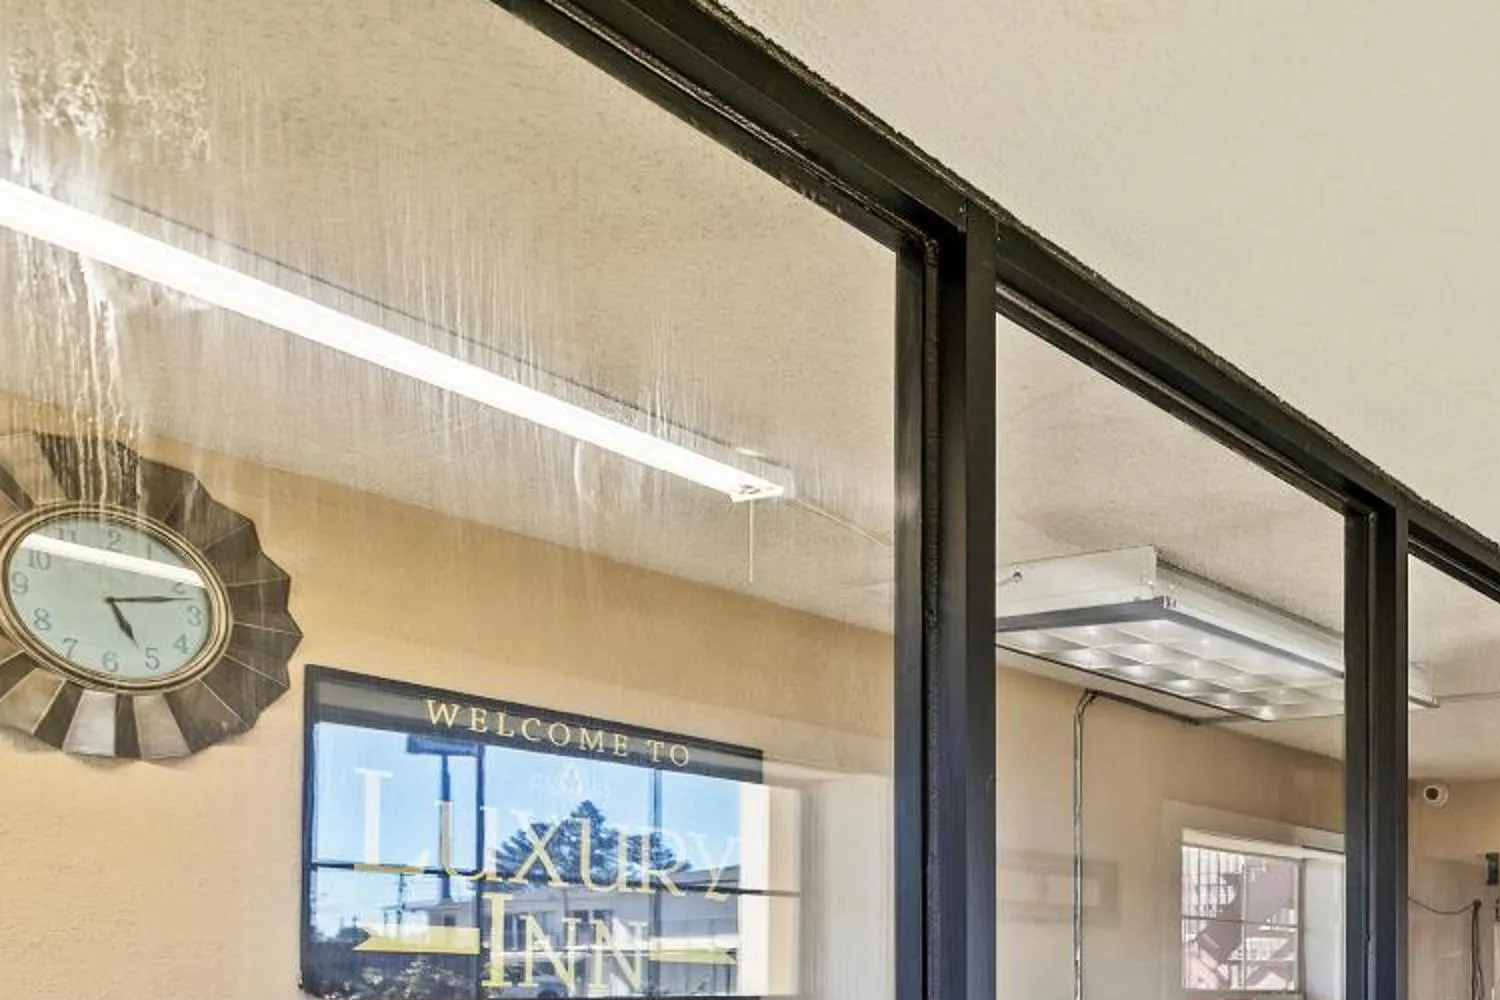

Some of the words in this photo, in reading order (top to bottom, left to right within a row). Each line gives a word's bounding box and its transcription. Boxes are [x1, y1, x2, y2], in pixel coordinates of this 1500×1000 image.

[28, 550, 50, 571] 10
[11, 572, 28, 595] 9
[33, 607, 51, 630] 8
[187, 605, 202, 627] 3
[63, 637, 80, 658] 7
[173, 632, 188, 654] 4
[103, 652, 119, 672] 6
[145, 648, 160, 670] 5
[426, 698, 631, 758] WELCOME
[646, 738, 691, 767] TO
[353, 768, 751, 901] LUXURY
[481, 891, 651, 993] INN
